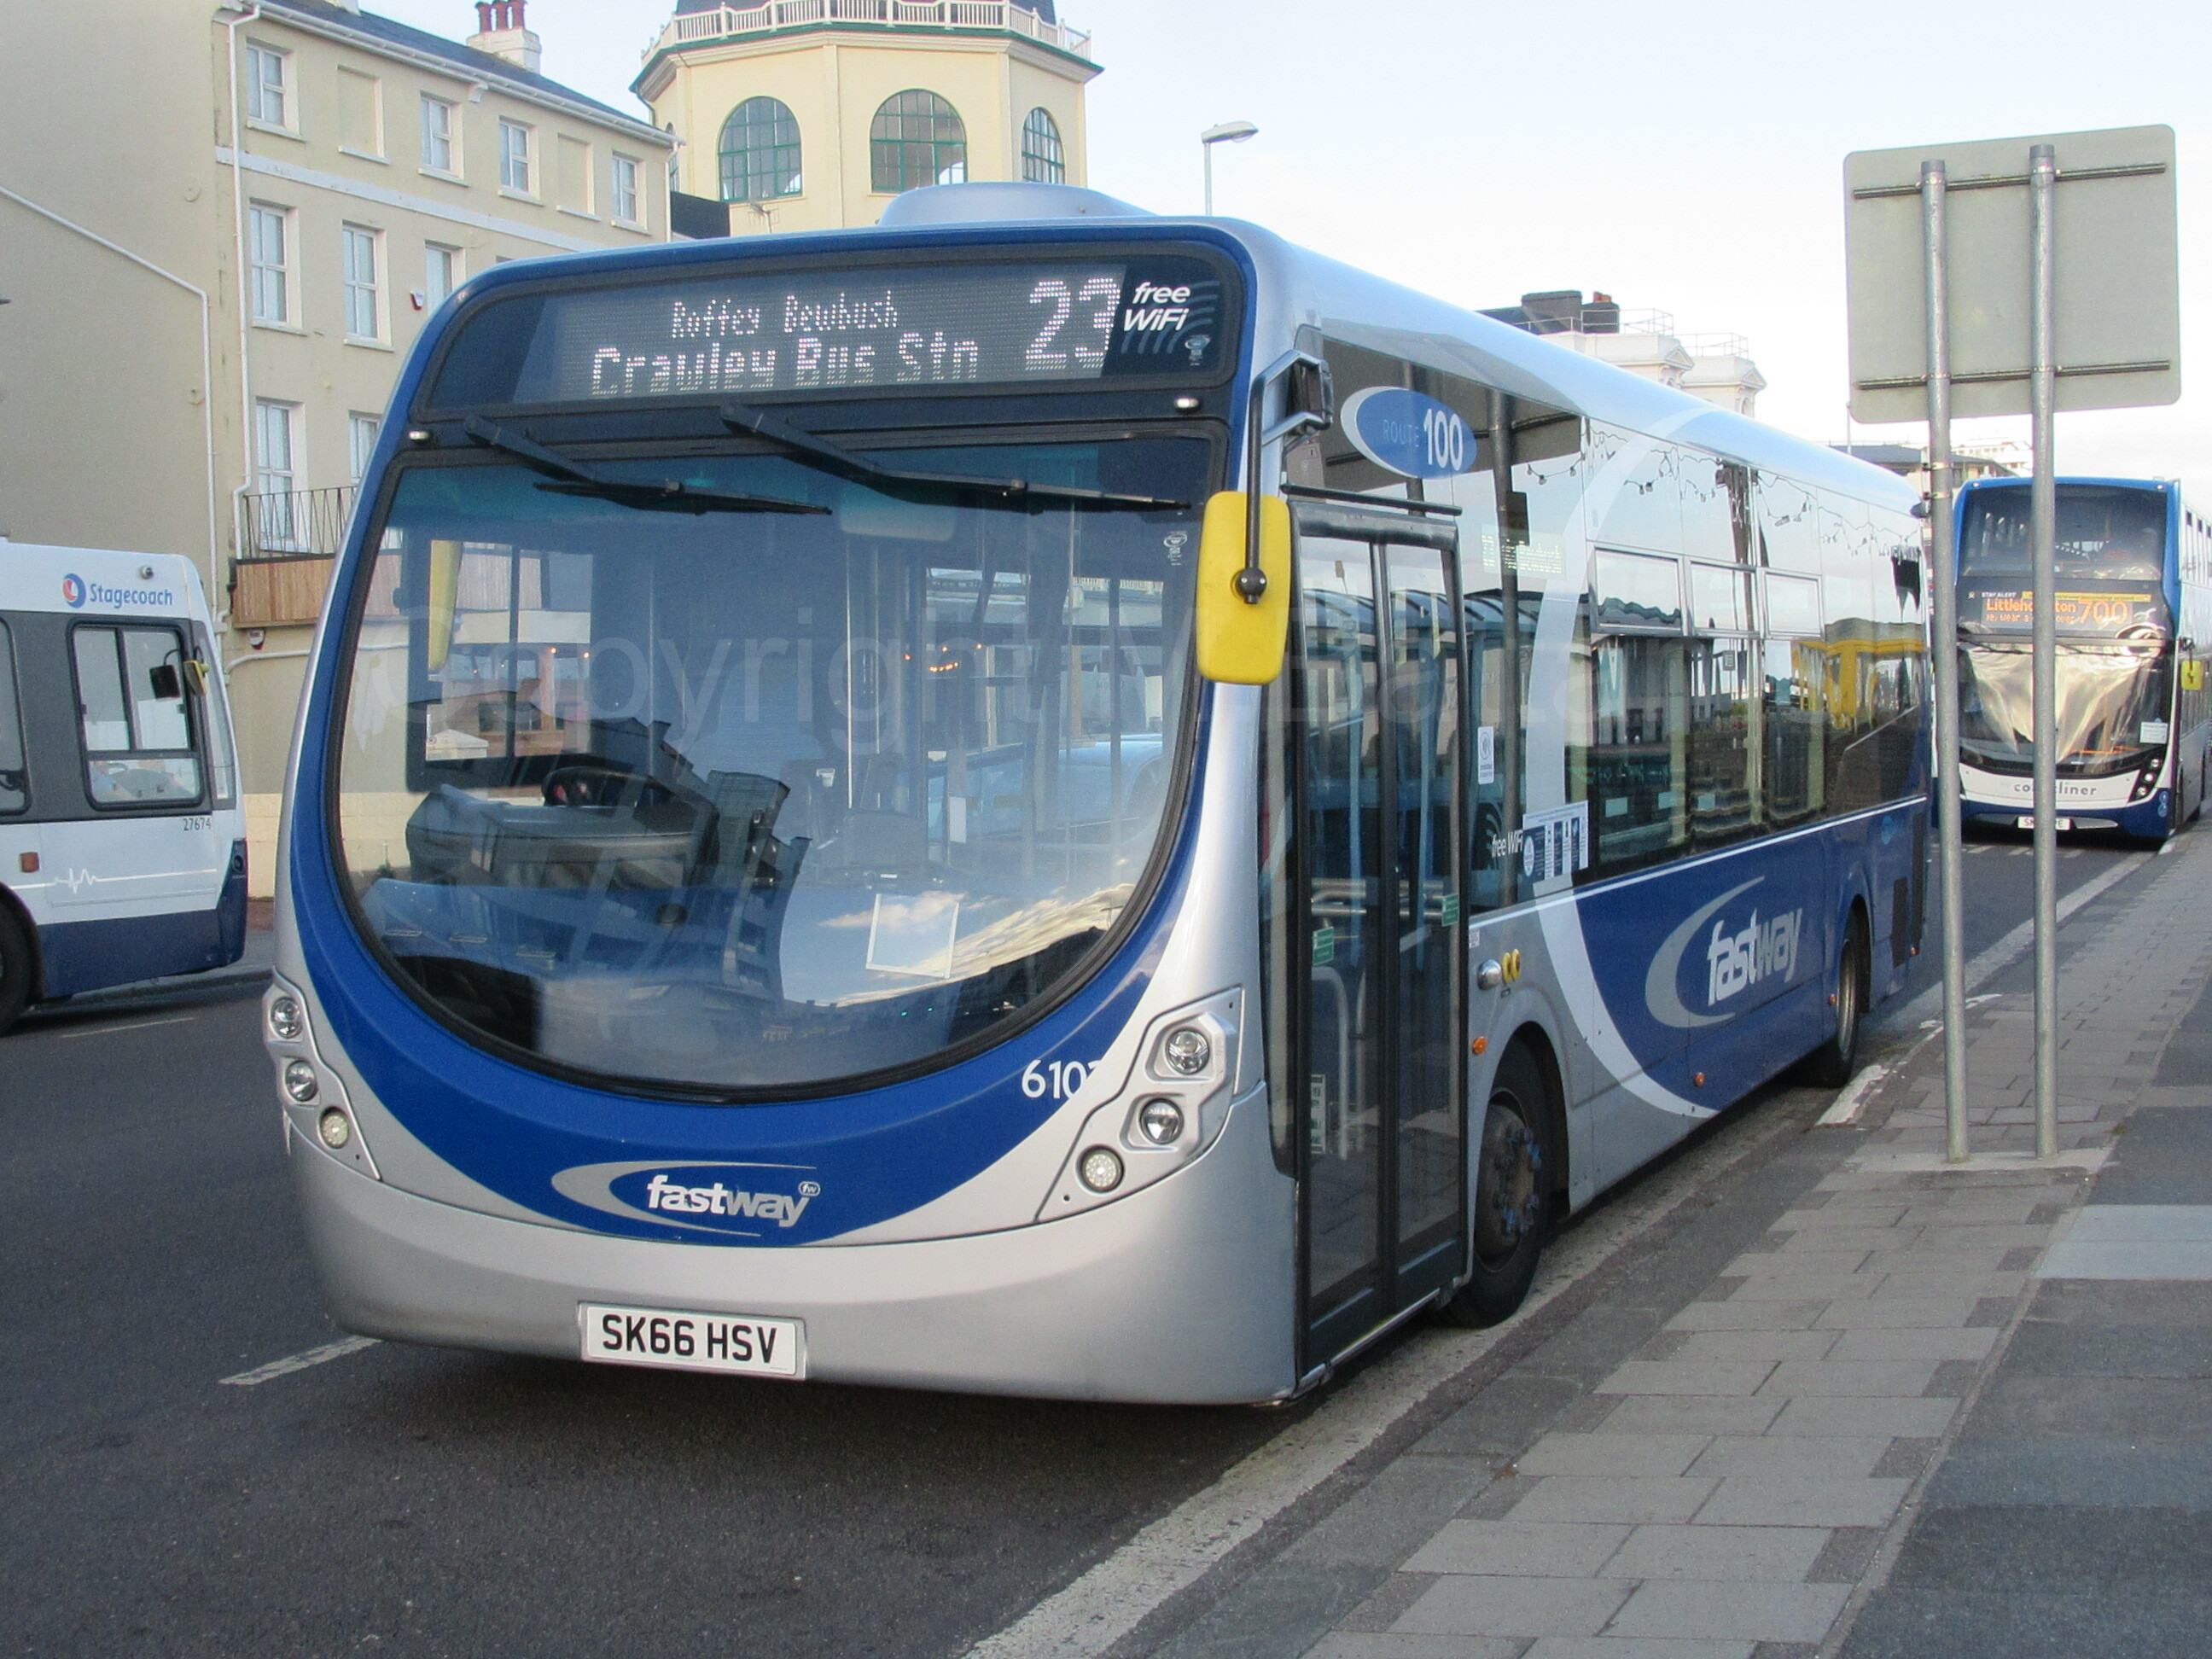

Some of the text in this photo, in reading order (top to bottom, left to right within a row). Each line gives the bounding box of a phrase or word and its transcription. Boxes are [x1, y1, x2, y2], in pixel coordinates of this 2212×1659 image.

[1132, 281, 1191, 305] free
[1025, 277, 1121, 371] 23
[1123, 307, 1190, 332] WiFi
[591, 330, 980, 395] Crawley Bus Stn
[1383, 408, 1463, 471] ROUTE 100
[89, 583, 173, 609] Stagecoach
[2078, 598, 2128, 625] 700
[2014, 782, 2097, 795] coliner
[183, 817, 212, 832] 27674
[1707, 907, 1803, 1007] fastway
[646, 1174, 810, 1227] fastway
[602, 1314, 777, 1364] SK66 HSV
